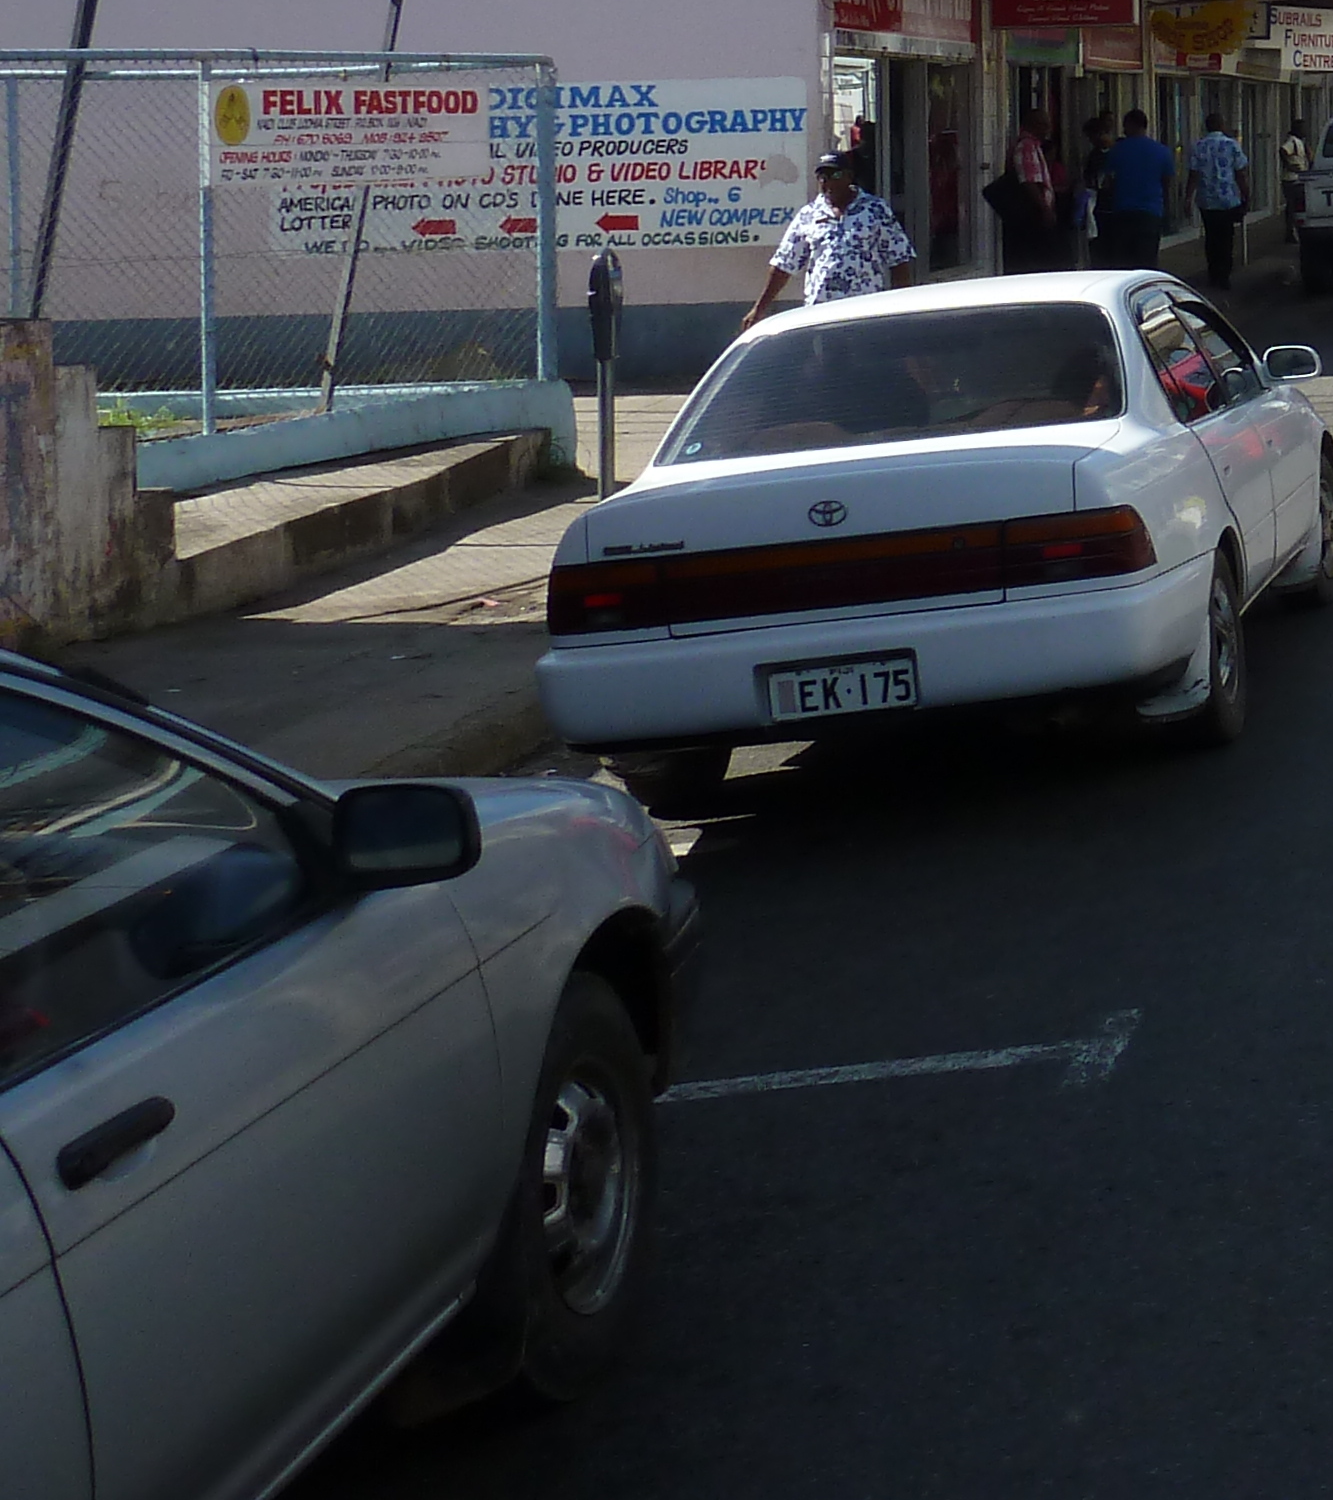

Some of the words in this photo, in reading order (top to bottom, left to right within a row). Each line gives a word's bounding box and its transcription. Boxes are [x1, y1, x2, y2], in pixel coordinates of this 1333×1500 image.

[1270, 7, 1322, 28] SUBRAILS
[262, 89, 344, 115] FELIX
[353, 89, 479, 115] FASTFOOD
[568, 108, 807, 138] PHOTOGRAPHY
[578, 139, 689, 157] PRODUCERS
[587, 163, 605, 181] &
[609, 161, 671, 181] VIDEO
[372, 193, 432, 210] PHOTO
[442, 193, 471, 210] ON
[479, 190, 519, 209] CD'S
[728, 186, 742, 202] 6
[279, 213, 352, 233] LOTTER
[660, 209, 705, 228] NEW
[708, 207, 795, 227] COMPLEX
[576, 233, 601, 247] FOR
[606, 232, 636, 246] ALL
